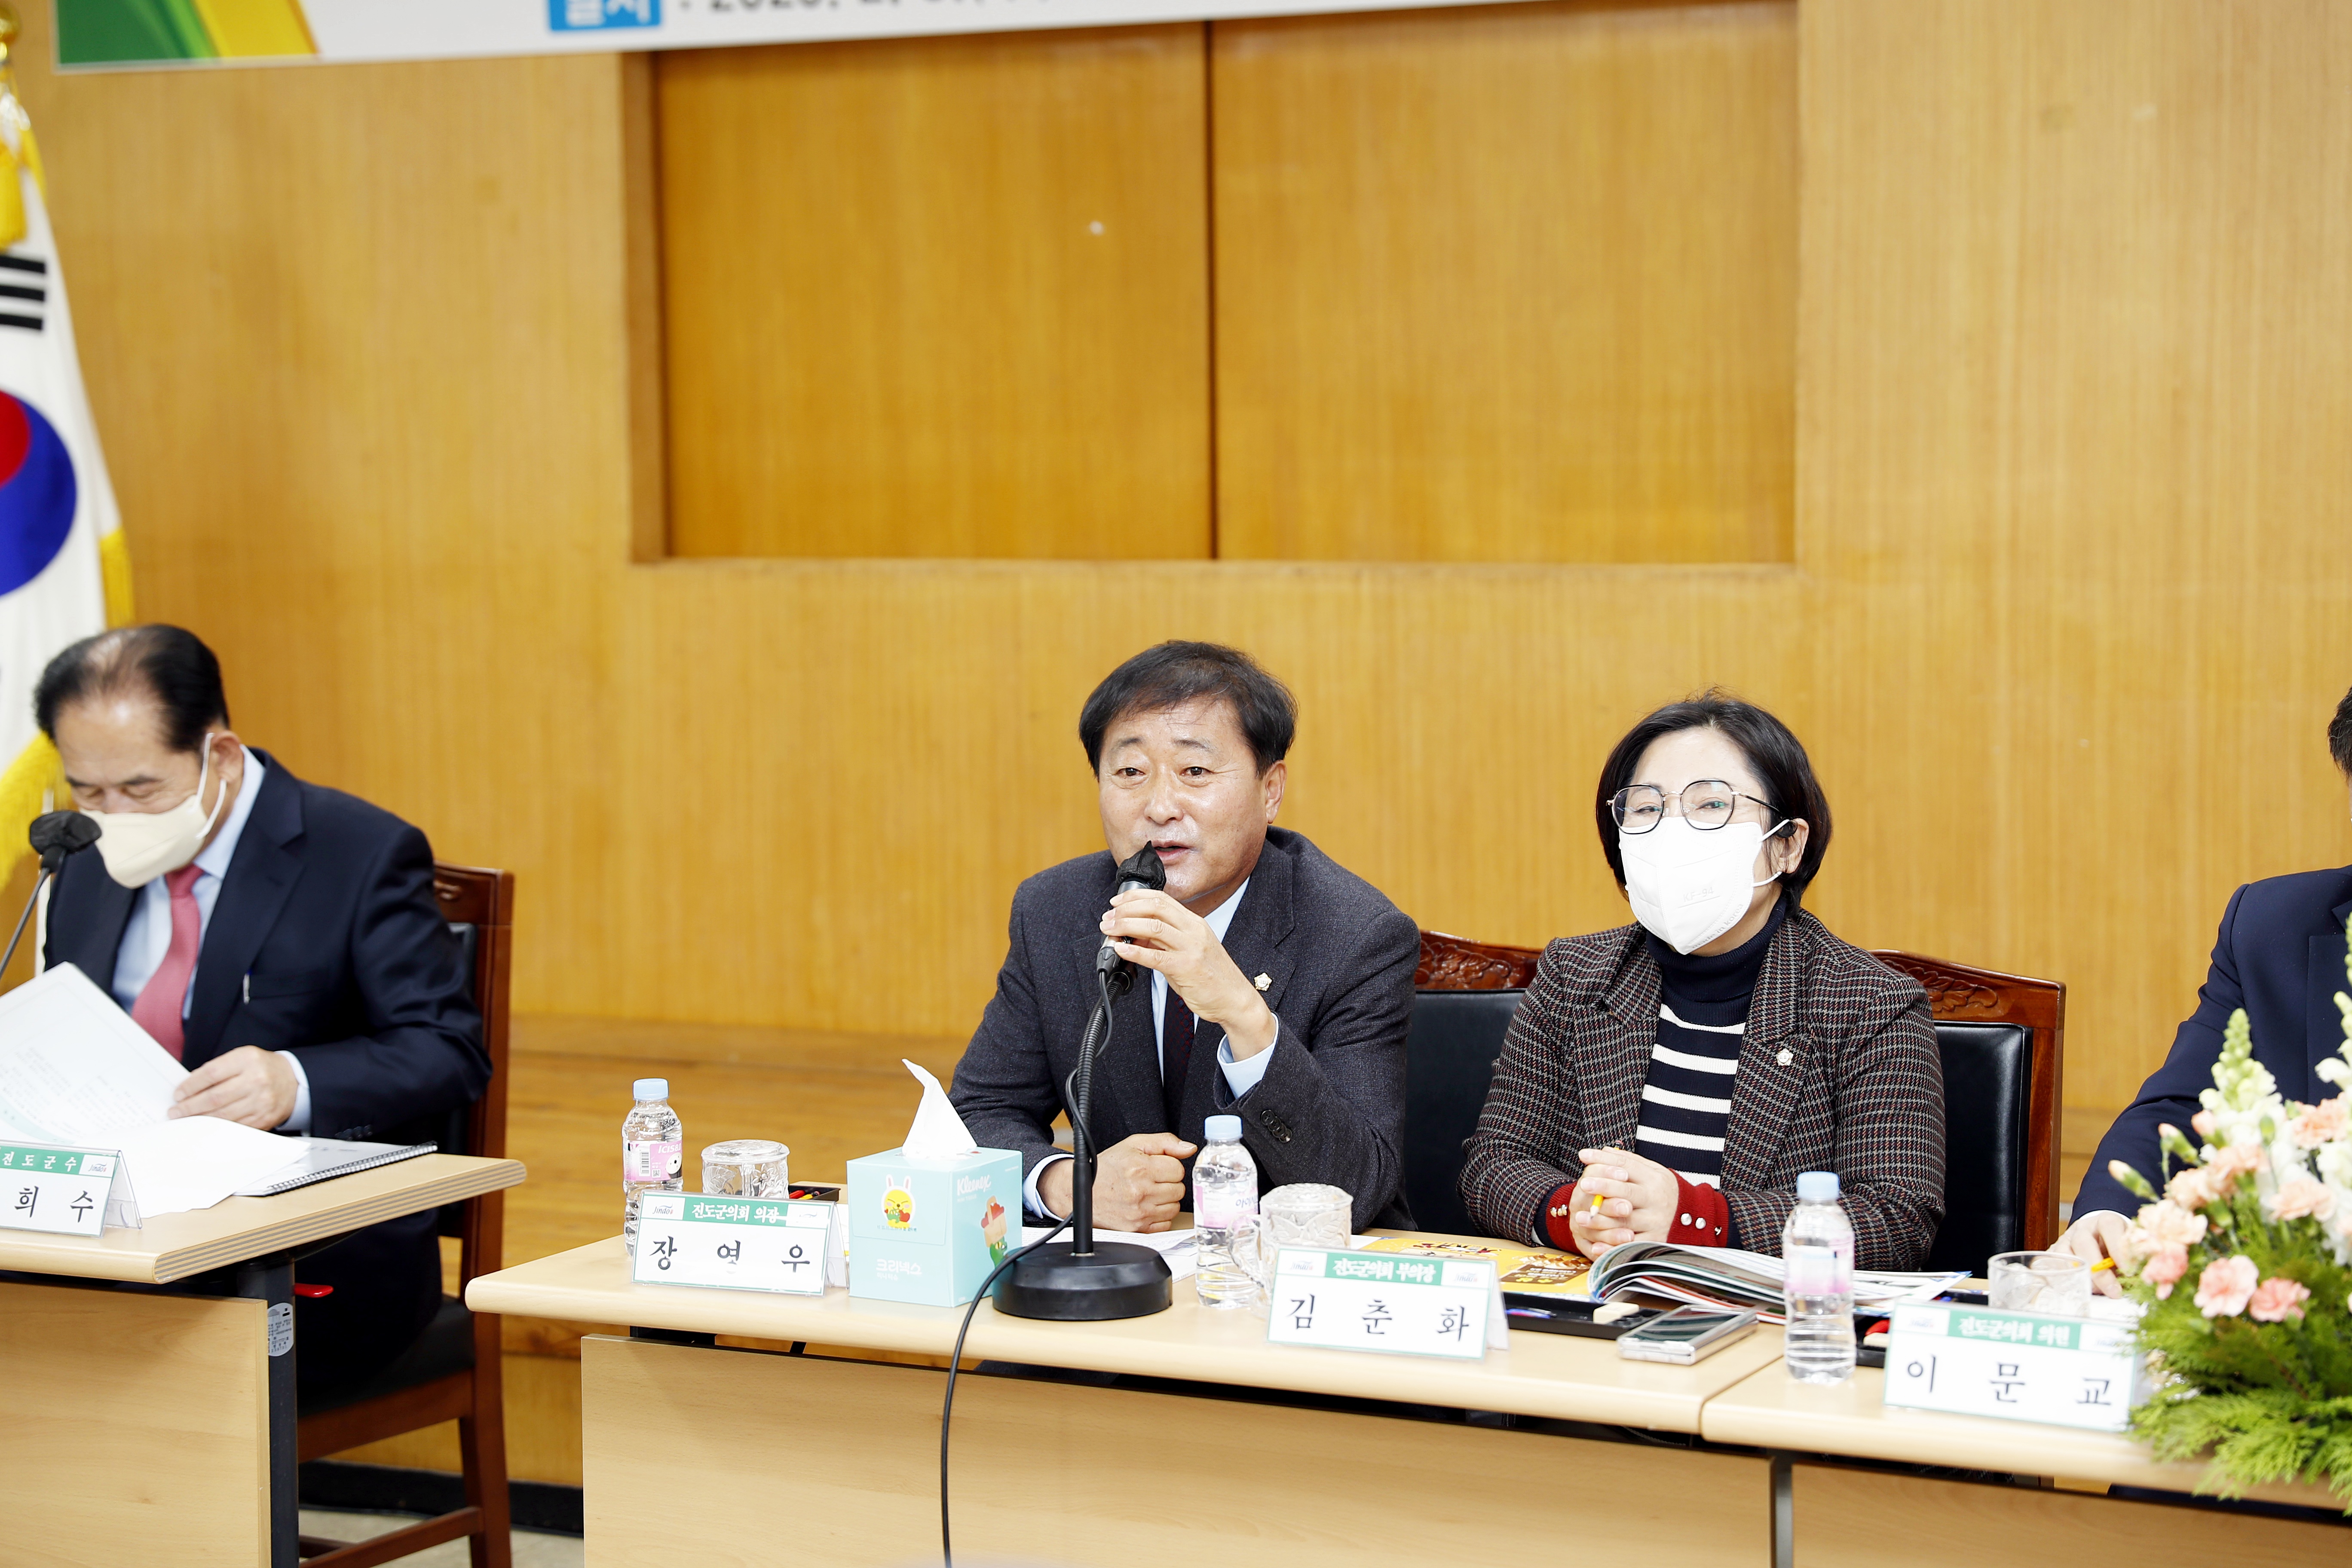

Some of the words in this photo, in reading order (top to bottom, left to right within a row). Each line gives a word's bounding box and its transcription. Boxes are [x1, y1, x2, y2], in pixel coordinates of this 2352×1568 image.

[1683, 886, 1714, 903] KF-94
[1724, 903, 1743, 926] korea
[957, 1174, 992, 1196] Kleenex
[692, 1202, 750, 1222] 진도군의회
[753, 1206, 780, 1224] 의장
[876, 1258, 922, 1276] 크리넥스
[1332, 1257, 1394, 1280] 진도군의회
[1396, 1262, 1436, 1283] 부의장
[1958, 1315, 2034, 1344] 진도군의회
